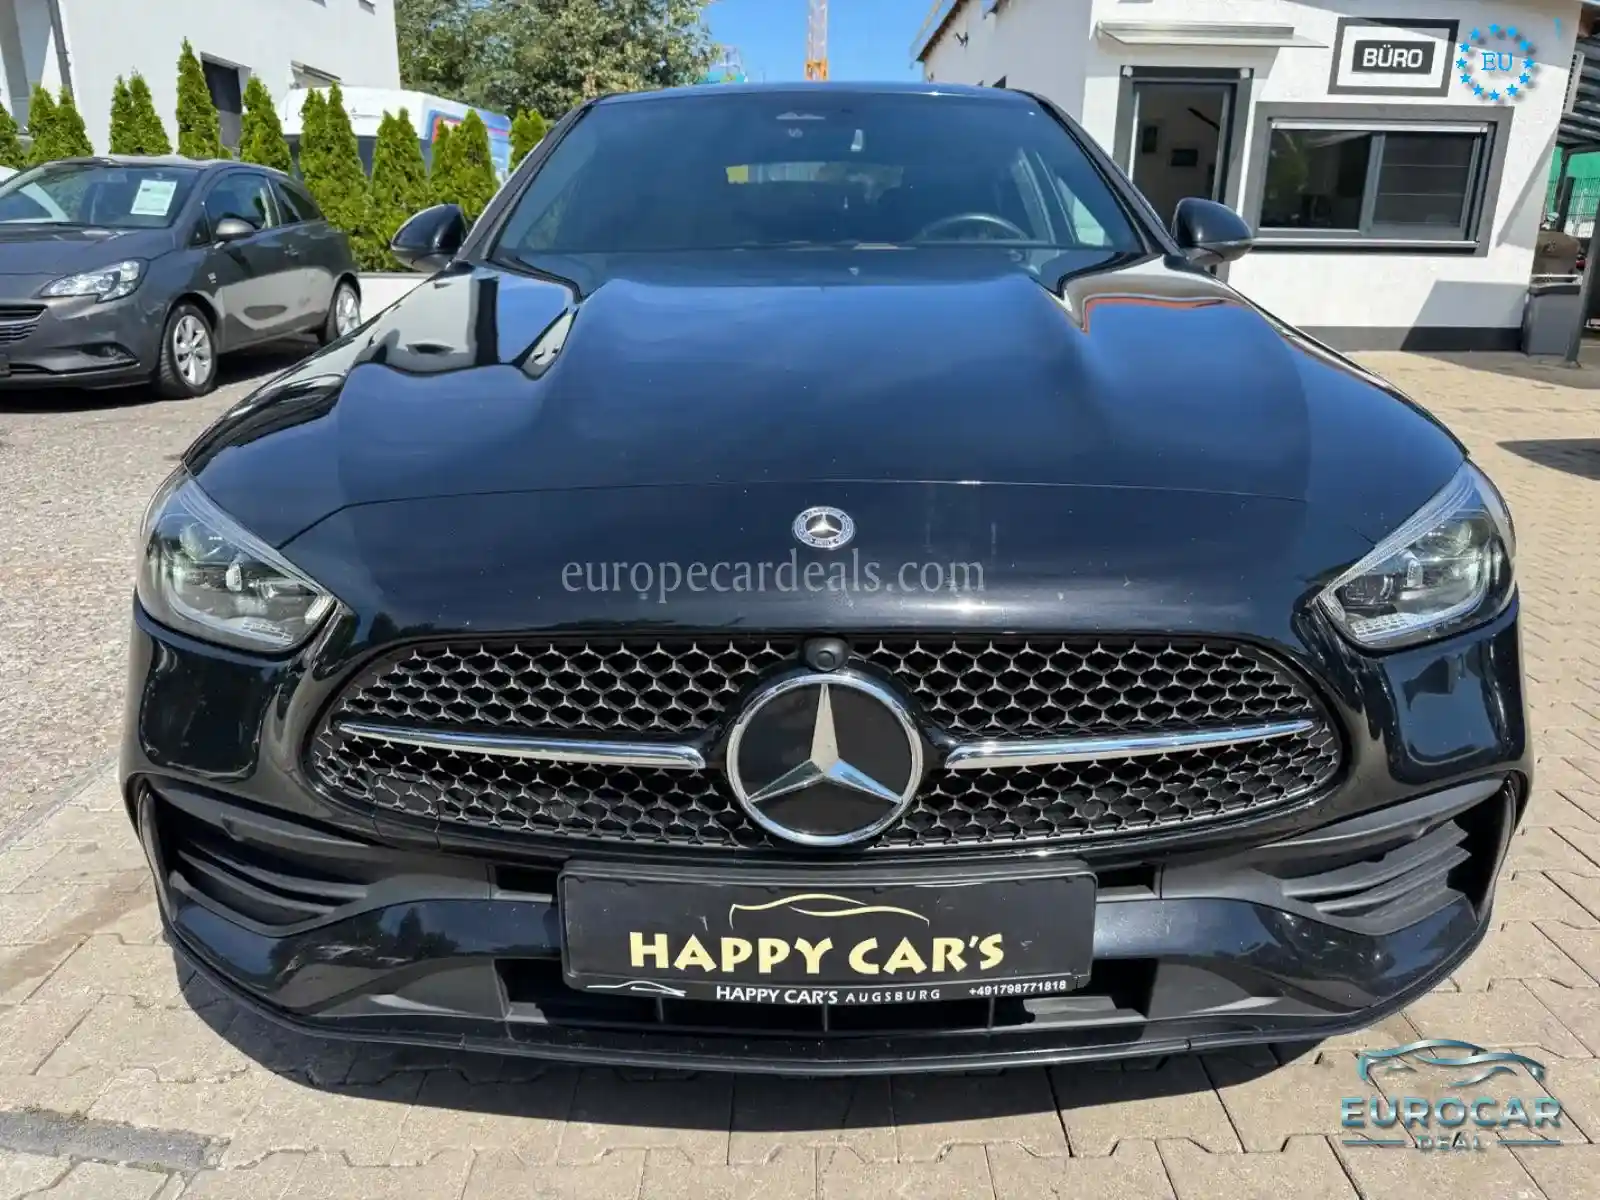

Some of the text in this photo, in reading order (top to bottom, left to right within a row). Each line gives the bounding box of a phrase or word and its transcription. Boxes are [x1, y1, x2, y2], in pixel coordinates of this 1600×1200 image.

[1362, 44, 1423, 69] BÜRO
[629, 931, 1005, 975] HAPPY CAR'S
[716, 985, 941, 1005] HAPPY CAR'S AUGSBURG
